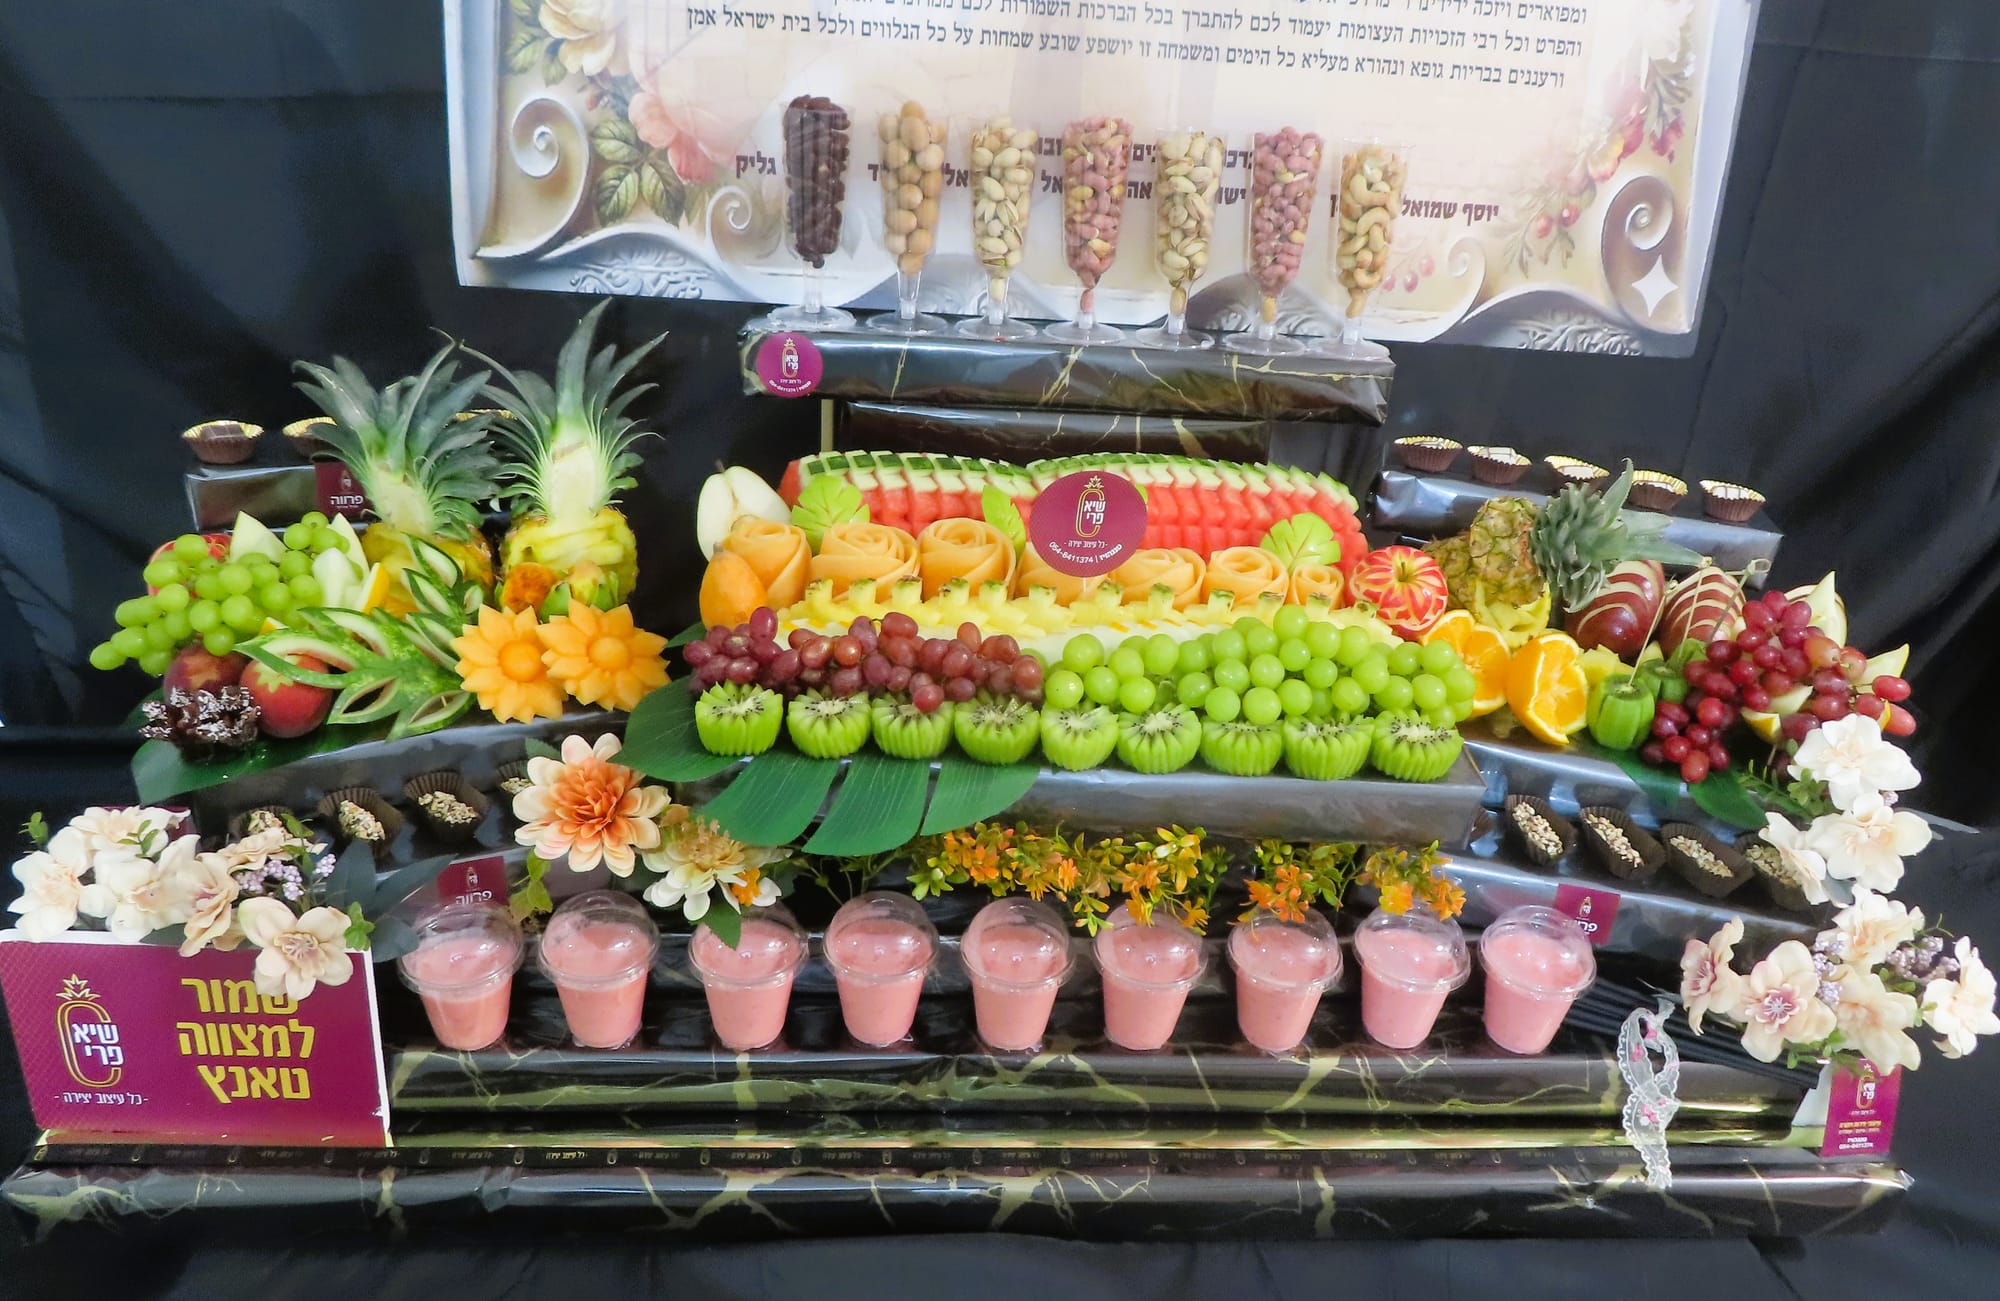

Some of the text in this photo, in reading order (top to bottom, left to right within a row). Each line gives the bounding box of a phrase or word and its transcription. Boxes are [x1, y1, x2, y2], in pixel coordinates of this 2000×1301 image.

[1000, 0, 1070, 17] השמורות
[1077, 2, 1136, 23] הברכות
[1145, 2, 1173, 24] בכל
[1473, 0, 1511, 18] ויזכה
[1517, 3, 1587, 24] ומפוארים
[1182, 8, 1243, 33] להתברך
[1250, 12, 1281, 32] לכם
[1289, 18, 1331, 38] יעמוד
[1337, 22, 1404, 43] העצומות
[1410, 27, 1466, 48] הזכויות
[1473, 33, 1498, 50] רבי
[1505, 30, 1529, 53] וכל
[687, 5, 1565, 89] ורעננים בבריות גופא ונהורא מעליא כל הימים ומשמחה זו יושפע שובע שמחות על כל הנלווים ולכל בית ישראל אמן
[1536, 38, 1582, 57] והפרט
[735, 151, 777, 179] גליק
[1401, 194, 1458, 219] שמואל
[1462, 204, 1500, 227] יוסף
[1084, 500, 1106, 512] שיא
[1086, 512, 1104, 525] פרי
[71, 1023, 120, 1045] שיא
[176, 1018, 315, 1059] למצווה
[84, 1045, 124, 1066] פרי
[197, 1065, 311, 1104] טאנץ
[63, 1092, 92, 1104] יצירה
[95, 1092, 125, 1105] עיצוב
